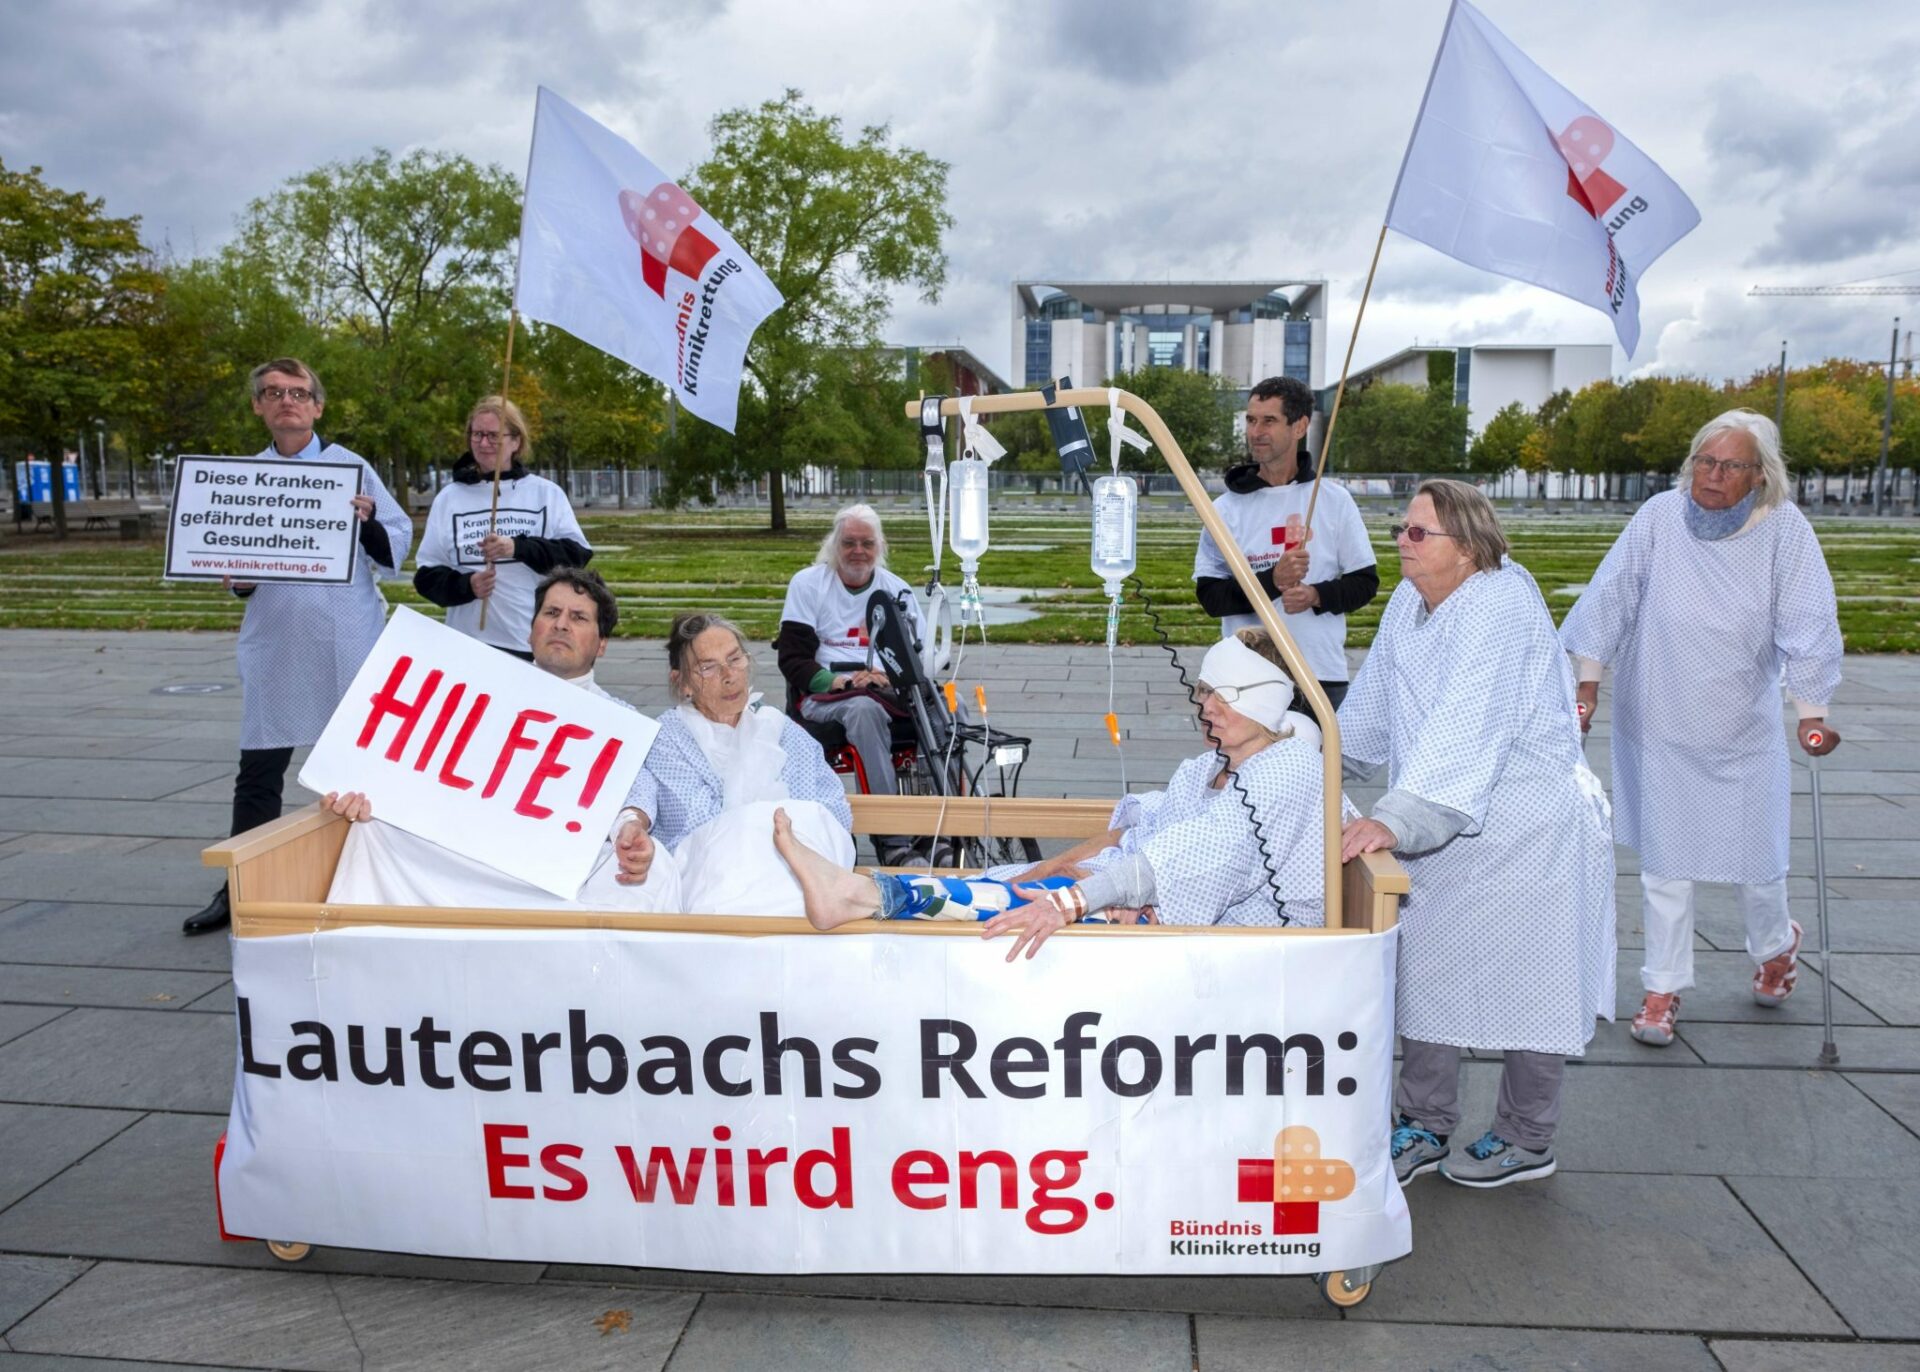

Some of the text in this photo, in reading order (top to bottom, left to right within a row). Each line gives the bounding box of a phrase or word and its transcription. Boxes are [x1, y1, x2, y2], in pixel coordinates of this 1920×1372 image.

[684, 257, 743, 397] Klinikrettung
[194, 470, 344, 490] Diese Kranken-
[210, 491, 322, 510] hausreform
[180, 511, 348, 531] gefährdet unsere
[463, 515, 537, 529] Kranenhaus
[203, 531, 320, 551] Gesundheit.
[191, 559, 328, 574] www.klinikrettung.de
[356, 655, 624, 833] HILFE!
[237, 996, 1359, 1100] Lauterbachs Reform:
[483, 1123, 1115, 1236] Es wird eng.
[1170, 1219, 1262, 1236] Bündnis
[1170, 1240, 1321, 1258] Klinikrettung
